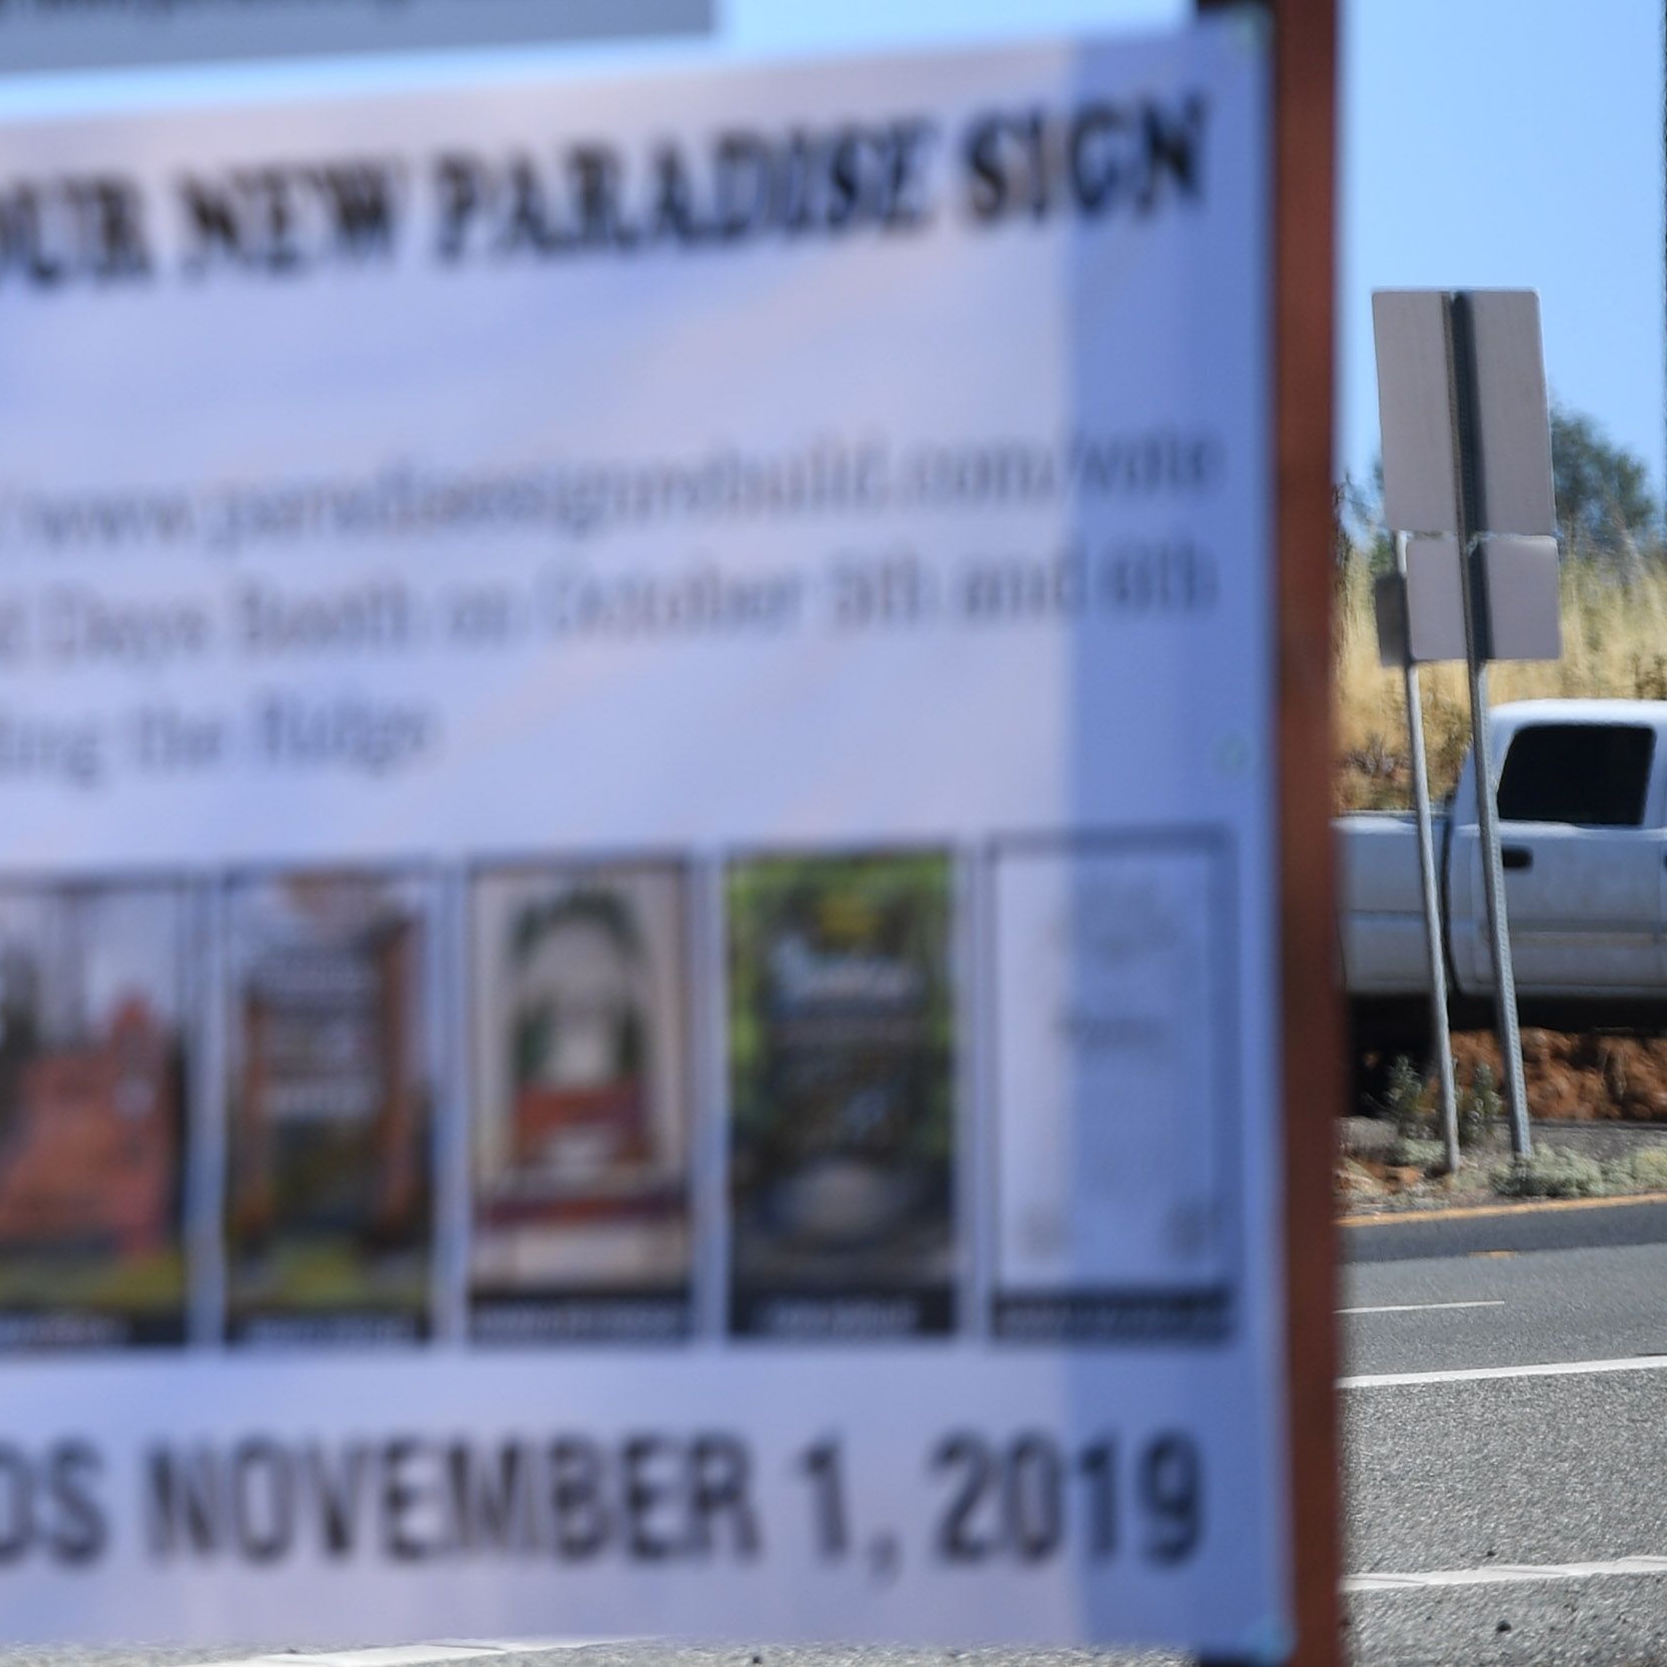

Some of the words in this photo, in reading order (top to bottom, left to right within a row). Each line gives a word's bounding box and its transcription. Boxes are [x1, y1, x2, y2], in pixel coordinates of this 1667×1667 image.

[178, 154, 396, 284] NEW
[437, 121, 939, 265] PARADISE
[962, 93, 1205, 228] SIGN
[958, 540, 1086, 619] and
[143, 1430, 760, 1569] NOVEMBER
[796, 1433, 900, 1592] 1,
[930, 1427, 1209, 1569] 2019
